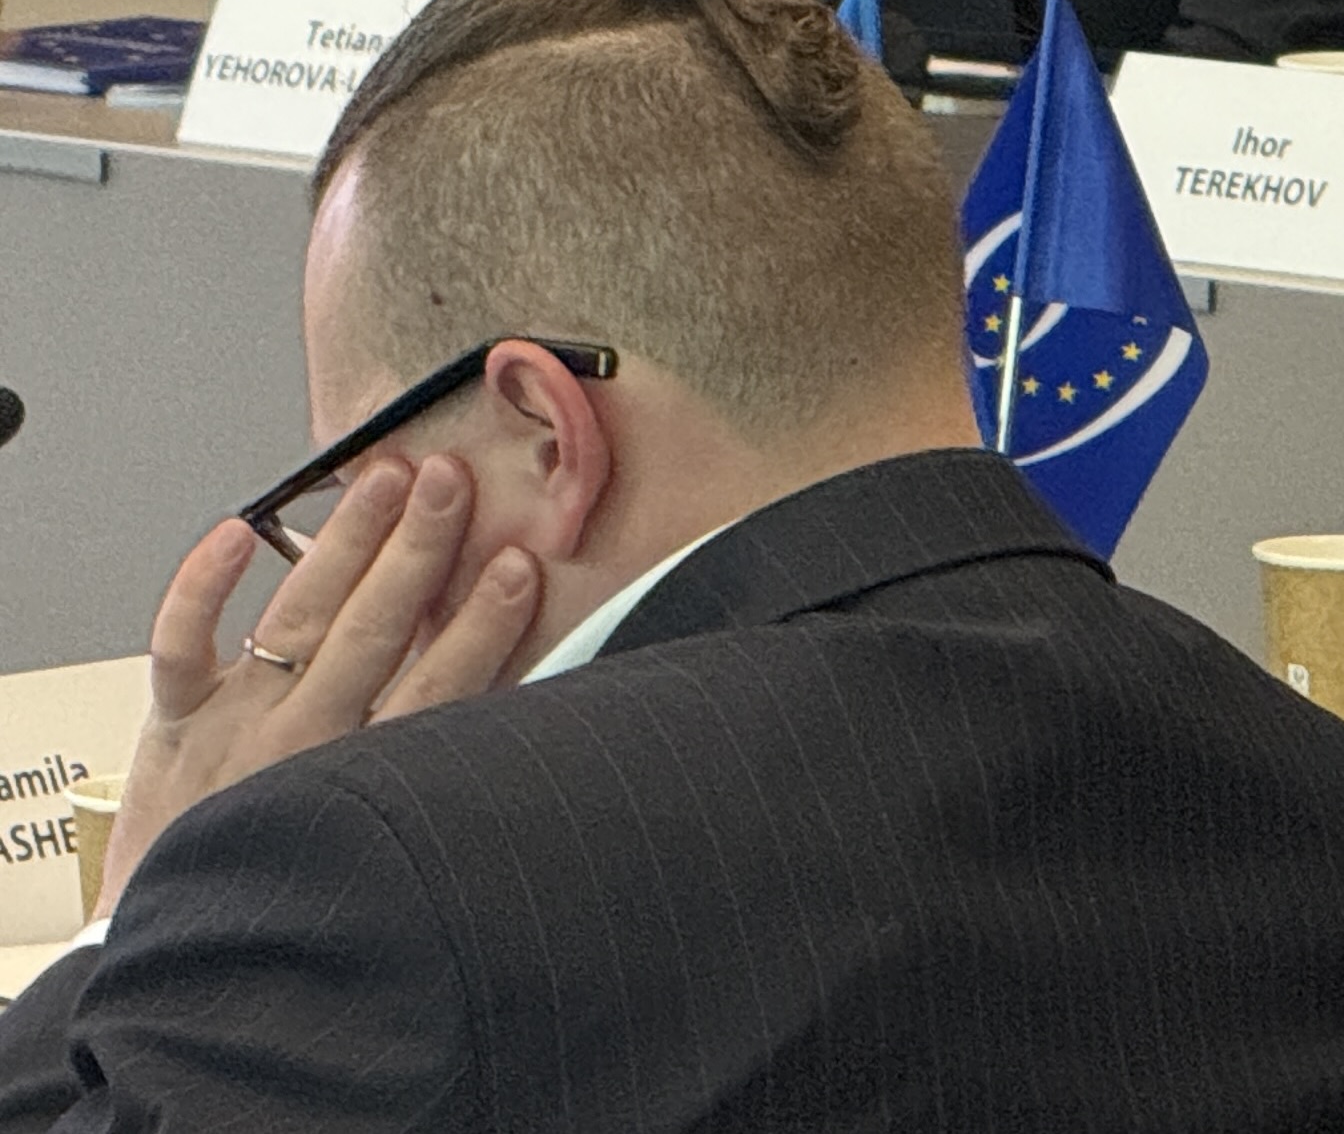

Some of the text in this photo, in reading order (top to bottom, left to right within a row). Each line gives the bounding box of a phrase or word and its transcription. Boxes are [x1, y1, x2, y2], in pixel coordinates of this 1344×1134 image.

[306, 20, 388, 54] Tetian
[1232, 126, 1292, 159] Ihor
[1175, 166, 1328, 207] TEREKHOV
